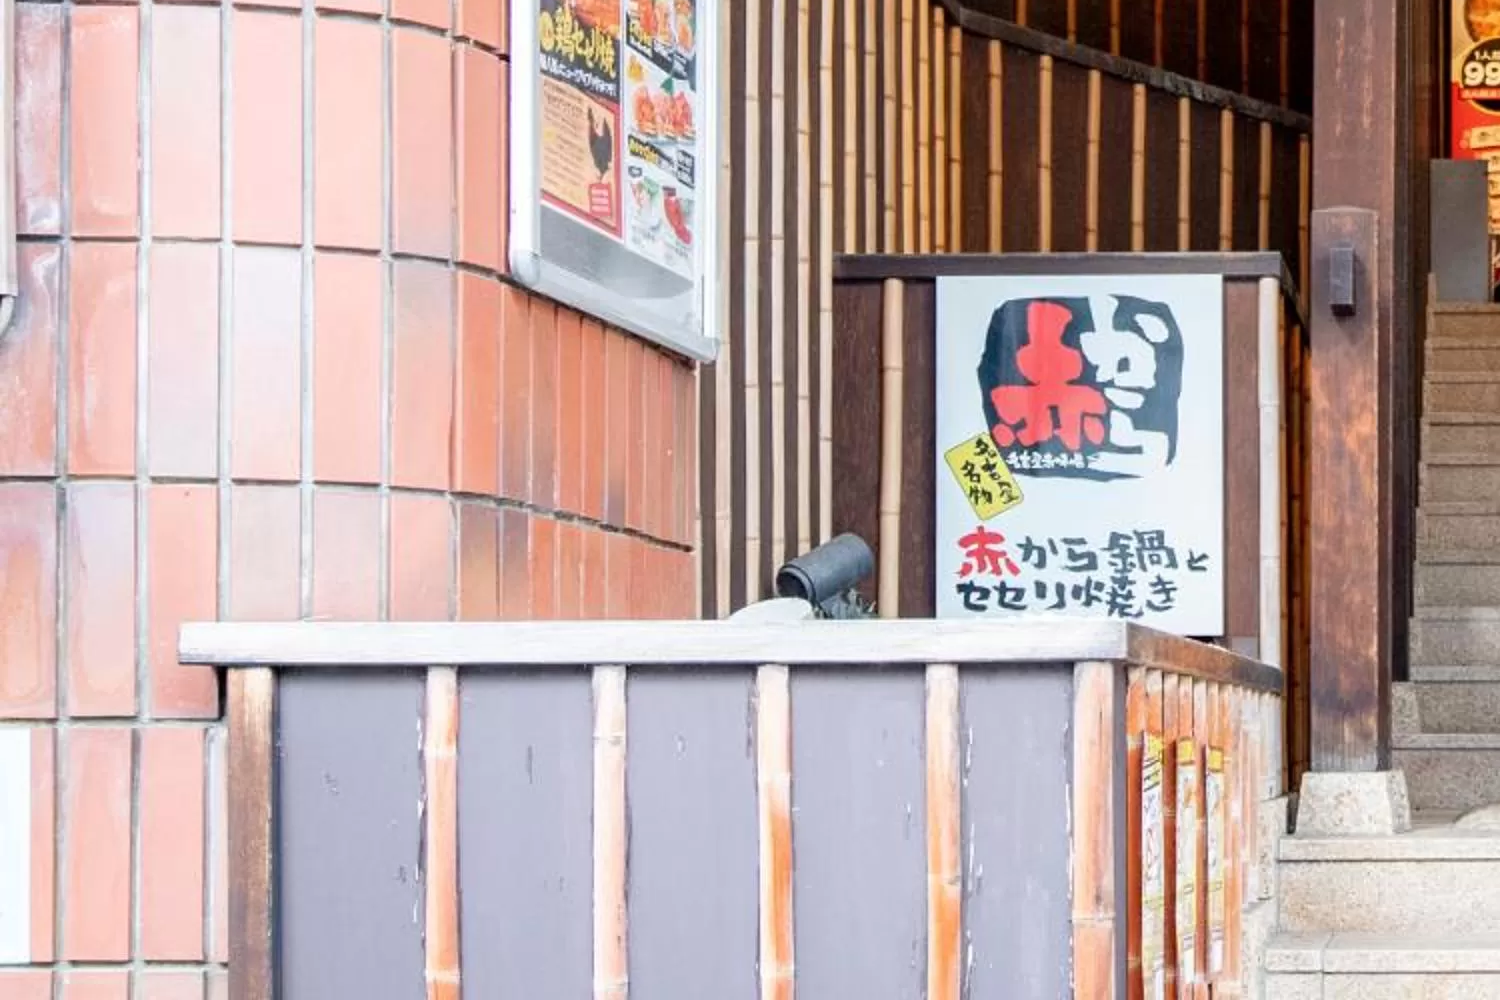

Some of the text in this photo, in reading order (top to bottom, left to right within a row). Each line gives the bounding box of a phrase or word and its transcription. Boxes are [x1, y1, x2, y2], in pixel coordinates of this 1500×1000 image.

[991, 296, 1170, 472] 赤から
[956, 526, 1209, 577] 赤から鍋と
[956, 575, 1178, 618] セセリ焼き
